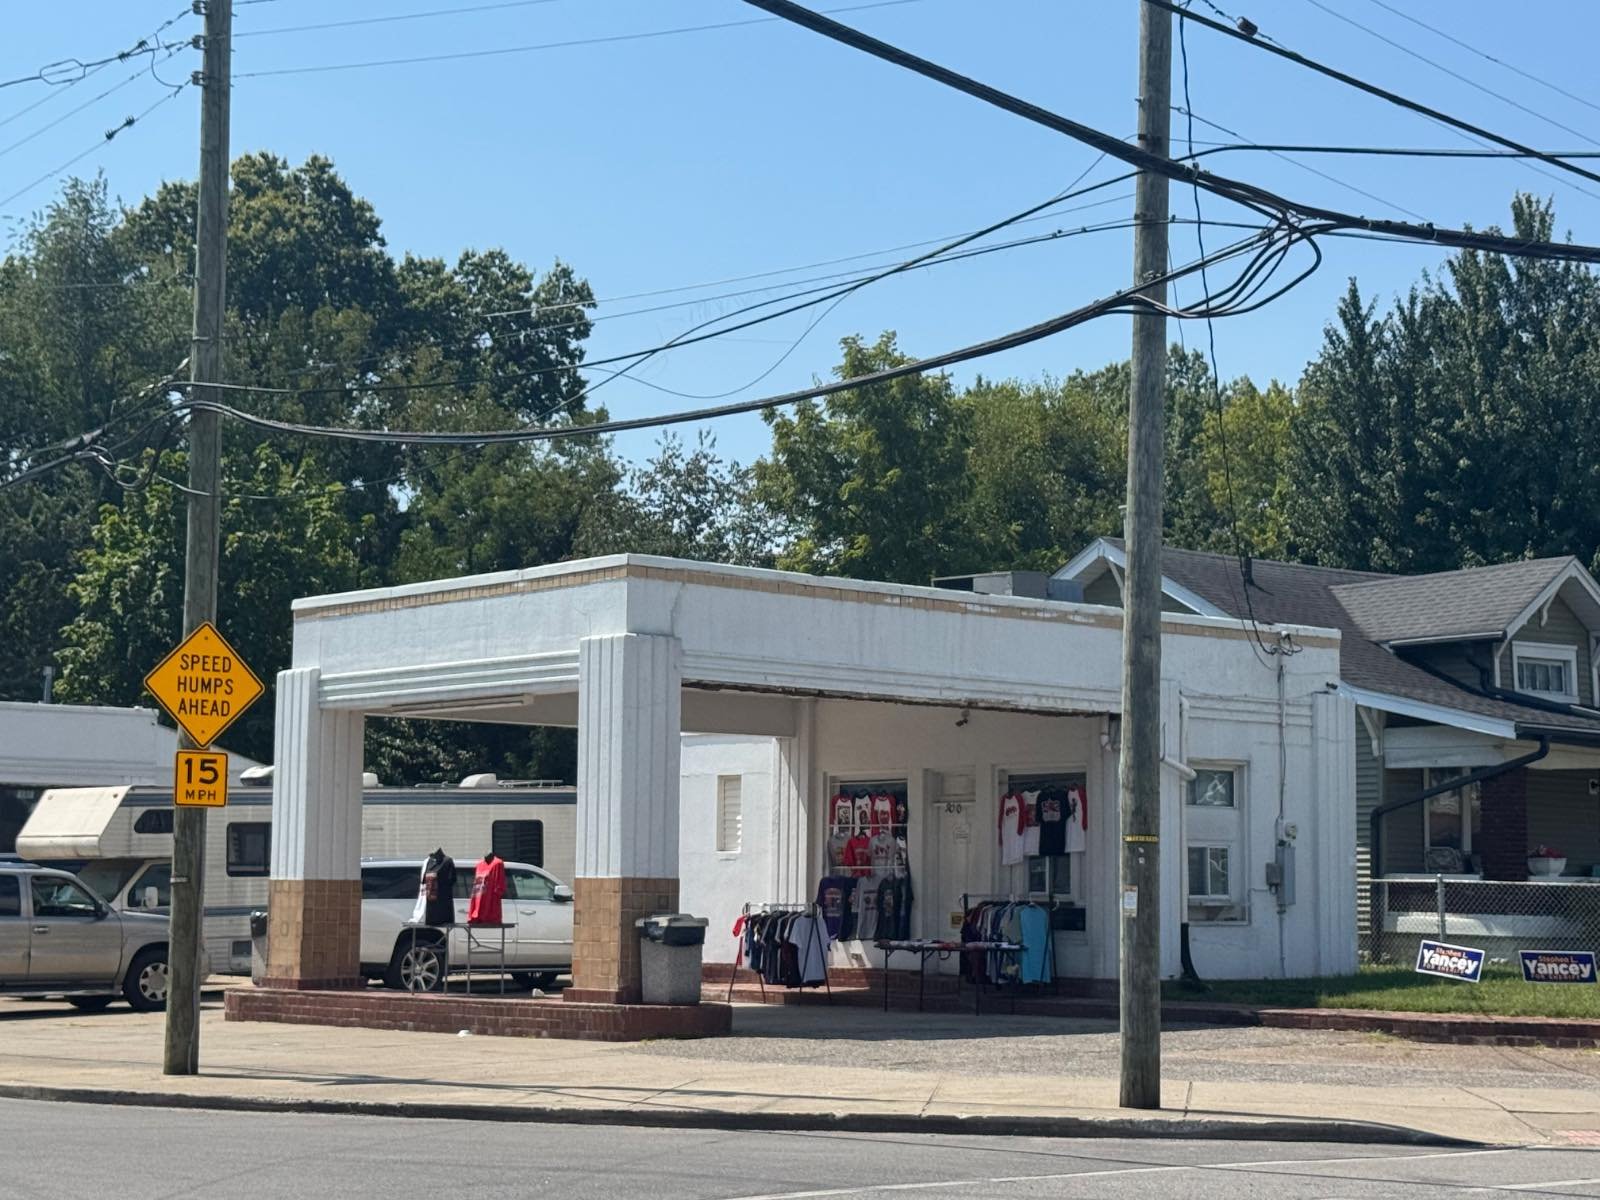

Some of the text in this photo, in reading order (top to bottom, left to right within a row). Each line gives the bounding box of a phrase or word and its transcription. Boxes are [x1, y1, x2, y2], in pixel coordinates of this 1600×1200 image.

[180, 654, 232, 673] SPEED
[177, 675, 234, 695] HUMPS
[177, 698, 231, 717] AHEAD
[184, 758, 219, 785] 15
[185, 789, 216, 801] MPH
[1423, 949, 1479, 975] Yancey
[1524, 959, 1592, 978] Yancey
